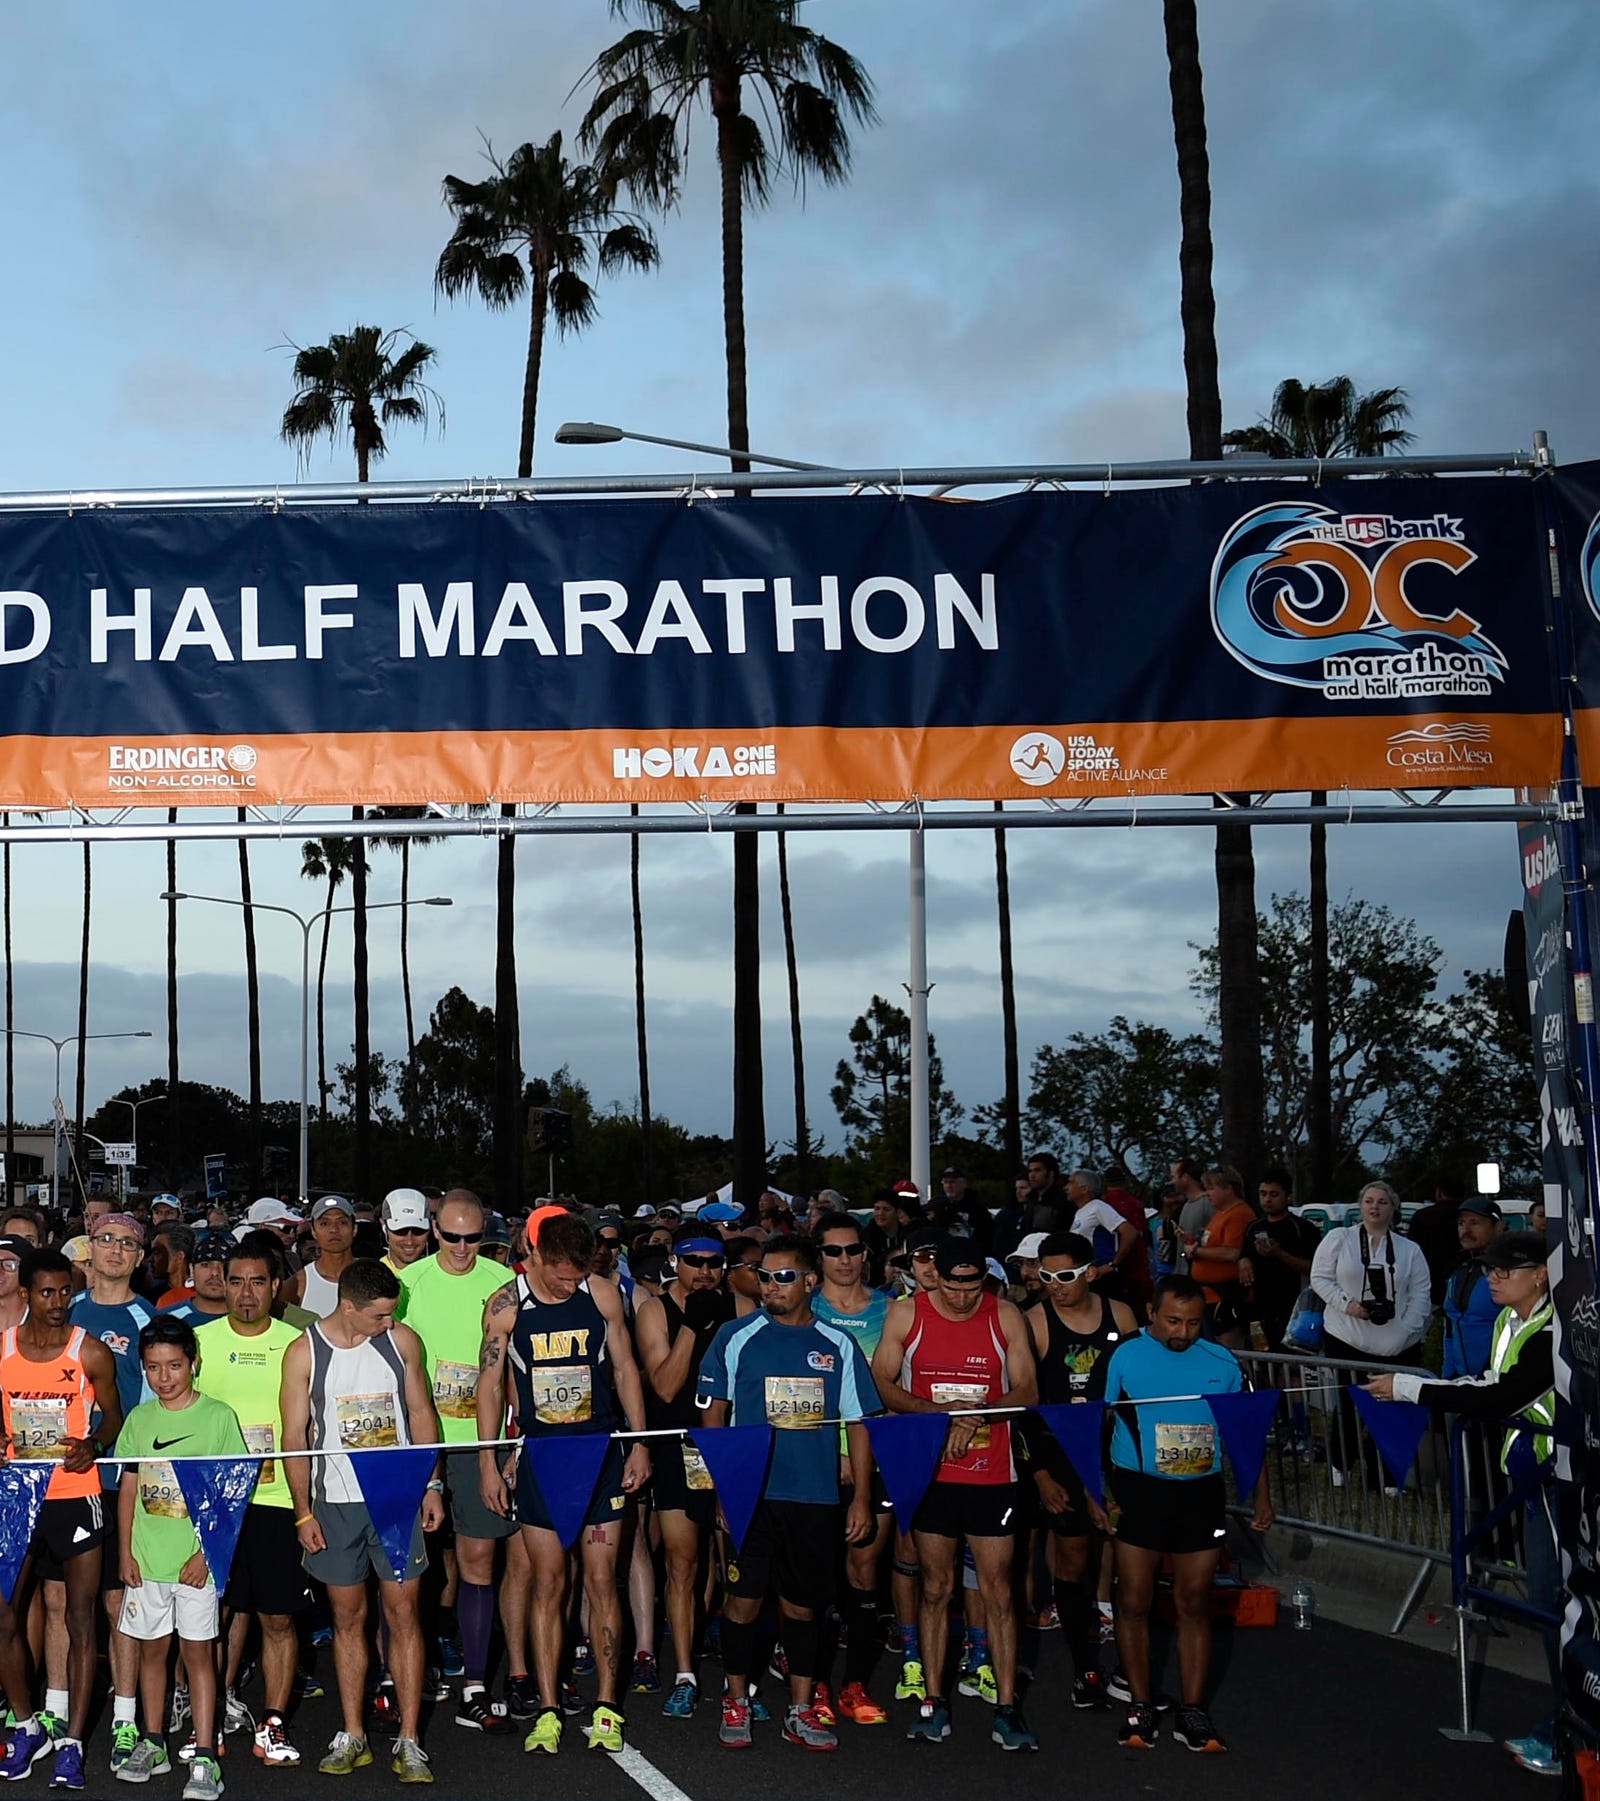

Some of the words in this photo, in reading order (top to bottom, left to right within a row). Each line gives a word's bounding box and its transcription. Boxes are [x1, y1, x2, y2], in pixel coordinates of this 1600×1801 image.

[1313, 526, 1344, 539] THE
[1261, 539, 1481, 638] OC
[90, 584, 358, 663] HALF
[398, 572, 999, 658] MARATHON
[1325, 646, 1486, 678] marathon
[1326, 681, 1359, 697] and
[1365, 679, 1398, 697] half
[1405, 677, 1489, 695] marathon
[1068, 736, 1095, 747] USA
[109, 745, 227, 772] ERDINGER
[734, 744, 775, 760] ONE
[1069, 747, 1114, 758] TODAY
[1386, 746, 1445, 766] Costa
[1449, 744, 1493, 764] Mesa
[613, 747, 733, 779] HOKA
[734, 760, 776, 776] ONE
[1068, 759, 1120, 770] SPORTS
[108, 774, 257, 789] NON-ALCOHOLIC
[1067, 769, 1109, 782] ACTIVE
[1111, 768, 1168, 781] ALLIANCE
[110, 1151, 130, 1160] 1:35
[831, 1317, 867, 1329] saucony
[530, 1328, 590, 1361] NAVY
[544, 1387, 583, 1403] 105
[769, 1400, 822, 1414] 12196
[341, 1416, 395, 1433] 12041
[20, 1429, 58, 1447] 125
[1158, 1447, 1213, 1460] 13173
[142, 1484, 182, 1502] 1292
